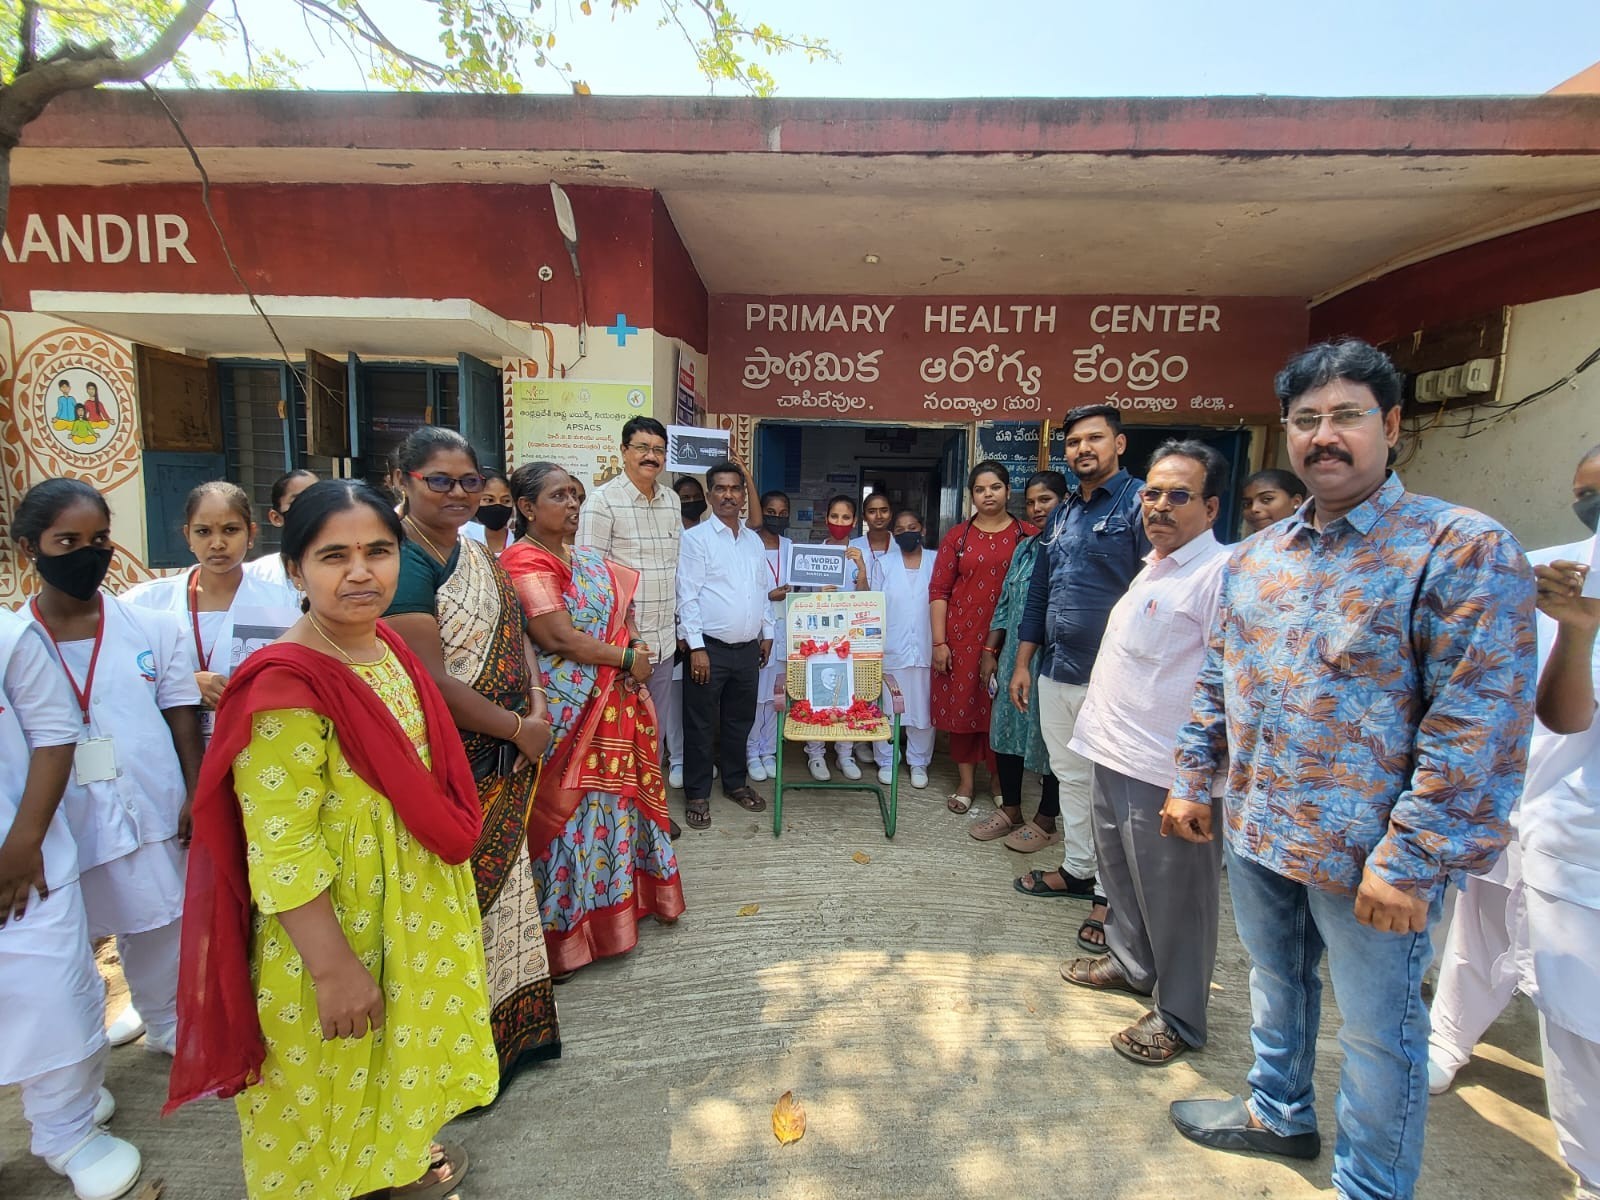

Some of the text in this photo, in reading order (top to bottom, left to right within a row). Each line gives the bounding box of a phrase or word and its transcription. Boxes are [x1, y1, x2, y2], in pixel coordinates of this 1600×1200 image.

[745, 303, 1221, 334] PRIMARY HEALTH CENTER
[741, 346, 884, 389] ప్రాథమిక
[919, 343, 1042, 396] ఆరోగ్య
[1072, 343, 1189, 391] కేంద్రం
[566, 423, 602, 432] APSACS
[995, 430, 1012, 441] పని
[811, 557, 839, 565] WORLD
